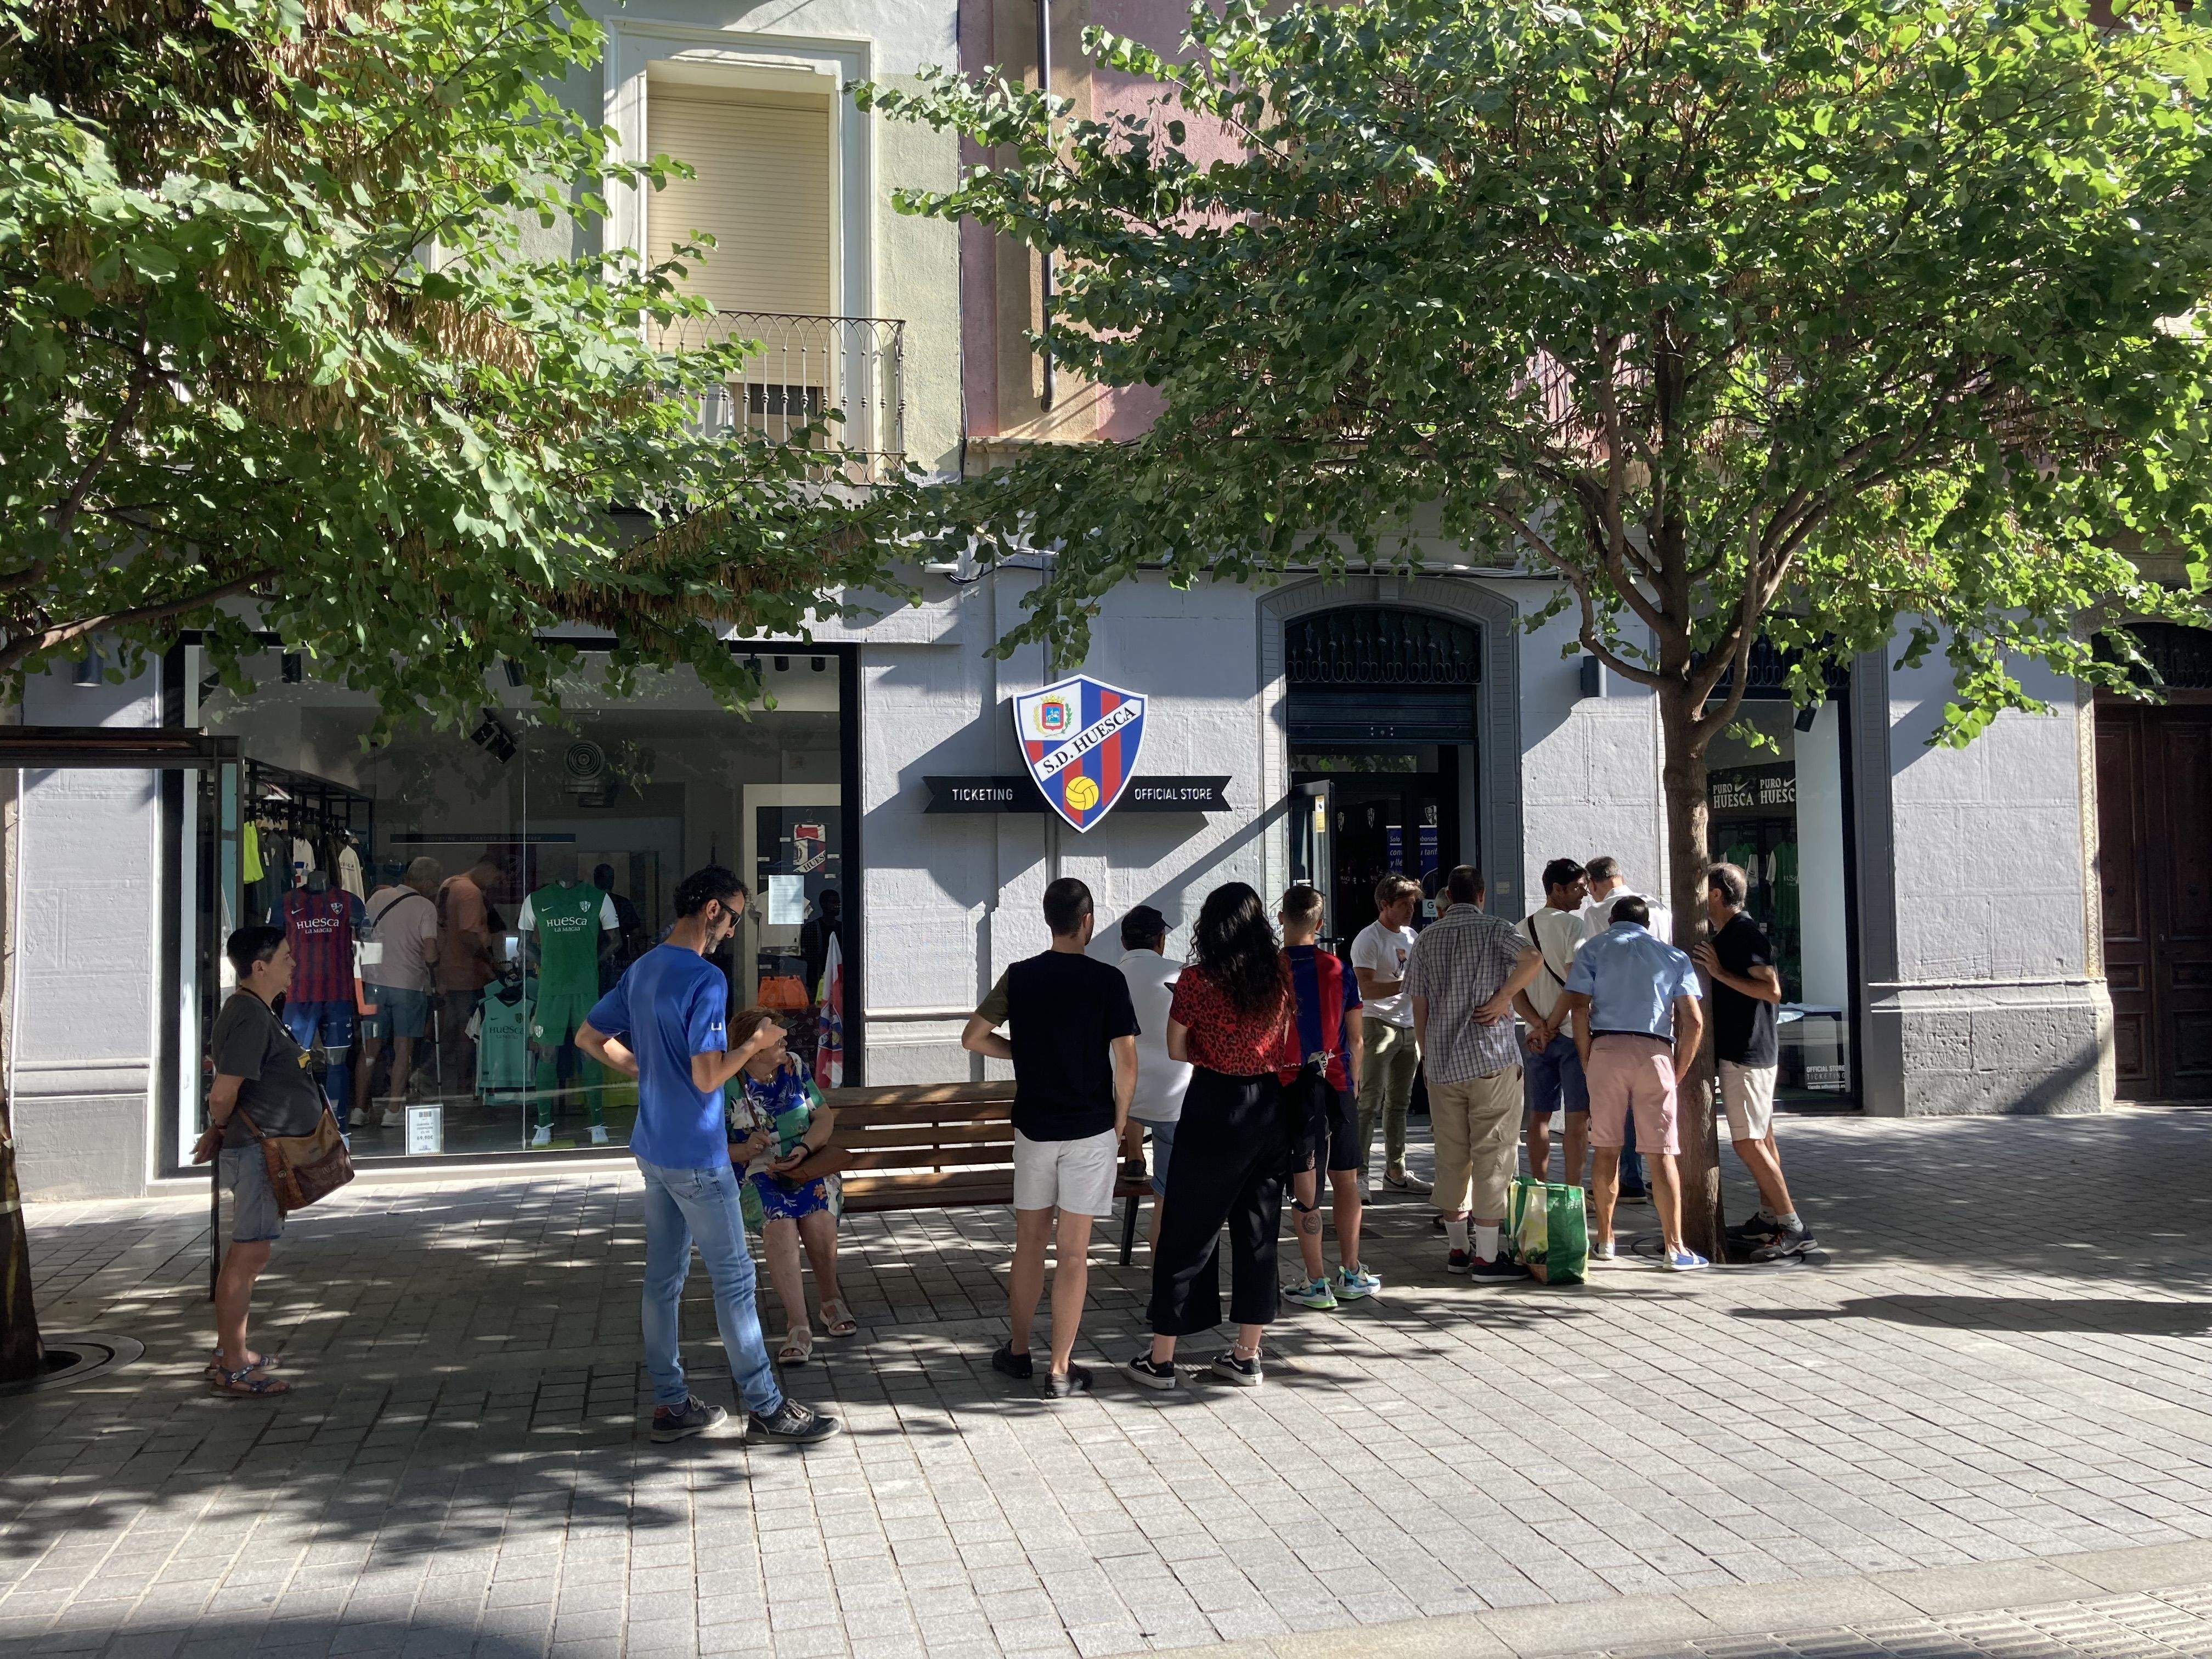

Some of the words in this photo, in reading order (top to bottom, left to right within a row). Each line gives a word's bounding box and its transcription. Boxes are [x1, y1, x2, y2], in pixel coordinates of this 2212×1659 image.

[1043, 751, 1074, 774] S.D.
[1072, 707, 1137, 754] HUESCA
[1713, 783, 1733, 794] PURO
[1760, 778, 1781, 789] PURO
[952, 788, 1013, 801] TICKETING
[1135, 788, 1178, 800] OFFICIAL
[1180, 788, 1213, 800] STORE
[1713, 792, 1754, 809] HUESCA
